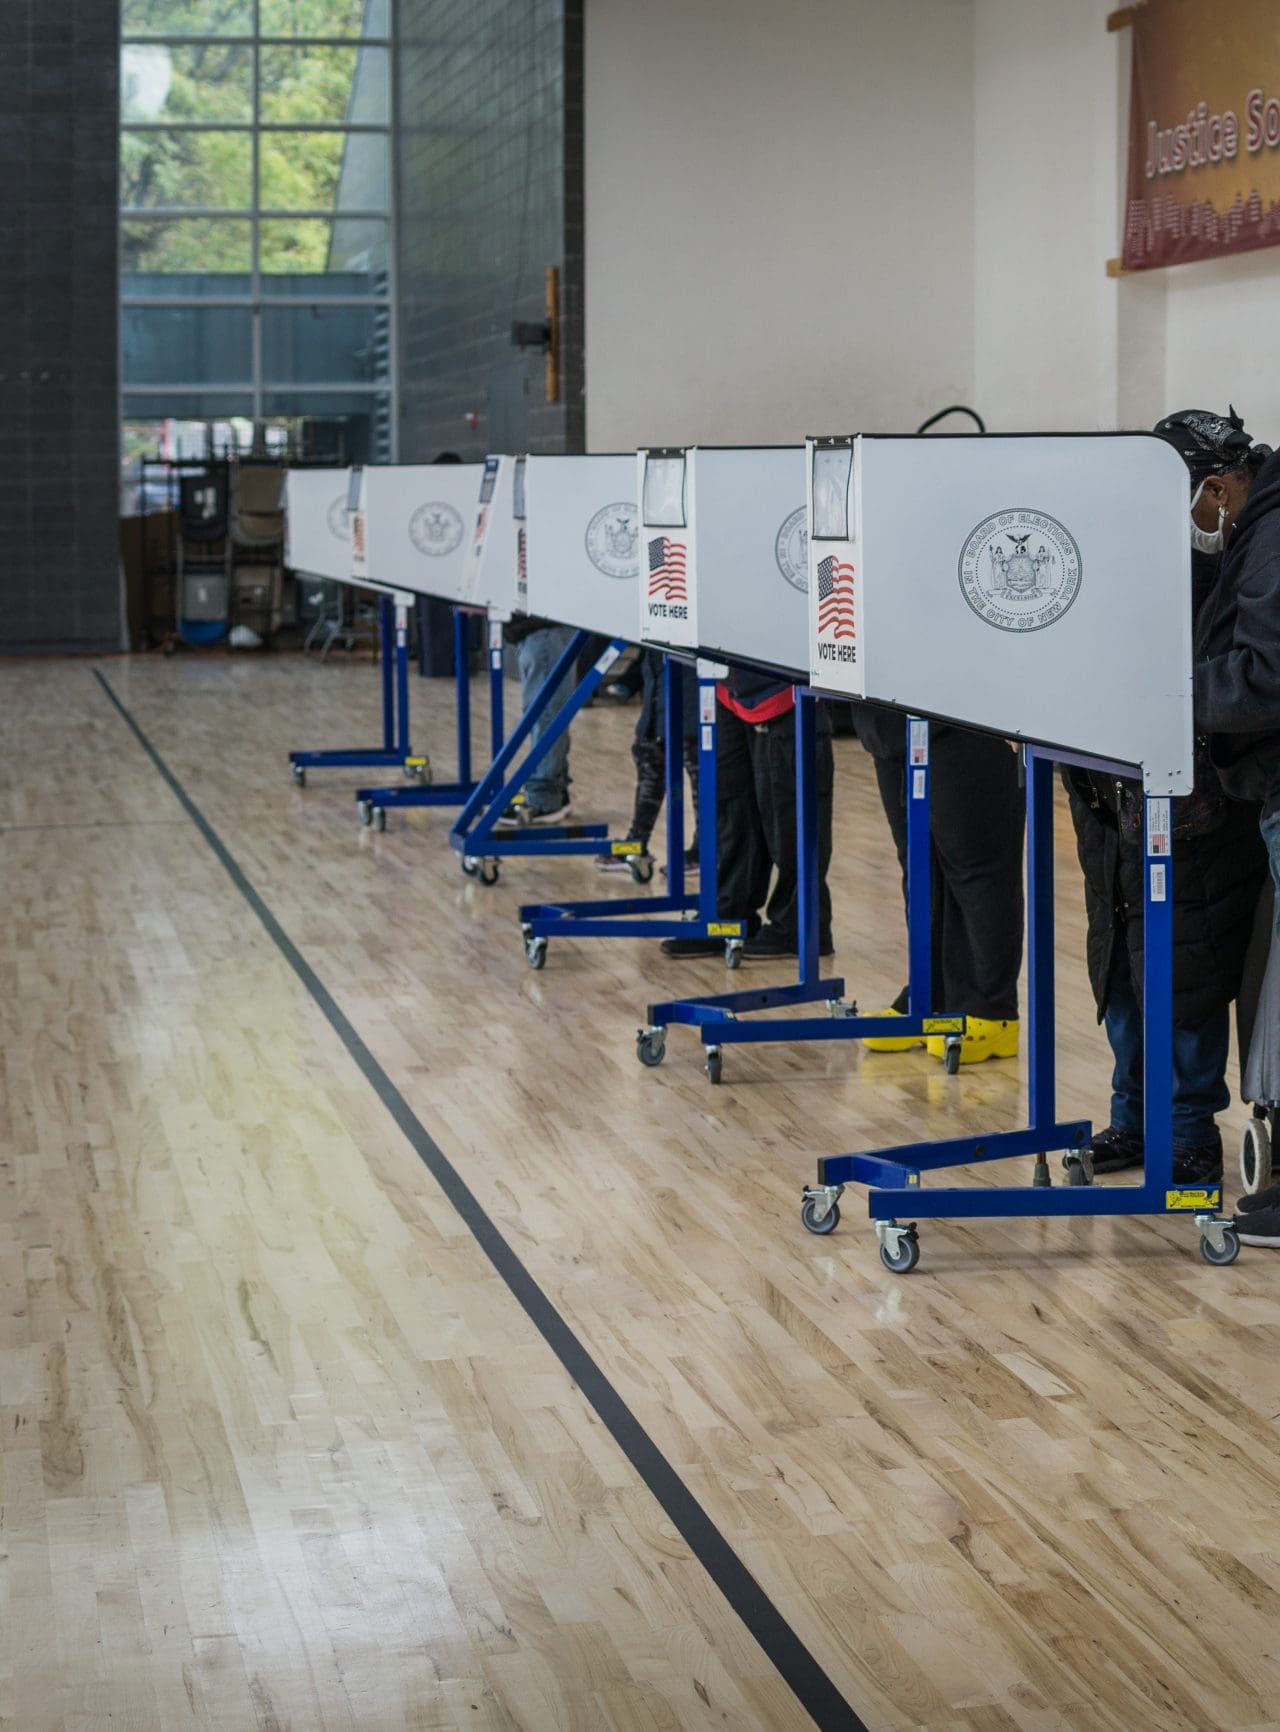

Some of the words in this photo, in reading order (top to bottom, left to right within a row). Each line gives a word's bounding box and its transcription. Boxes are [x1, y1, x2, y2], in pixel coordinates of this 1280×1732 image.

[1145, 101, 1238, 179] Justice
[966, 522, 996, 558] BOARD
[999, 514, 1014, 526] OF
[1018, 513, 1073, 556] ELECTIONS
[648, 602, 667, 617] VOTE
[669, 605, 688, 620] HERE
[968, 586, 987, 611] THE
[986, 609, 1015, 626] CITY
[1018, 617, 1034, 627] OF
[1038, 601, 1062, 623] NEW
[1060, 568, 1077, 601] YORK
[818, 642, 836, 660] VOTE
[837, 644, 856, 663] HERE
